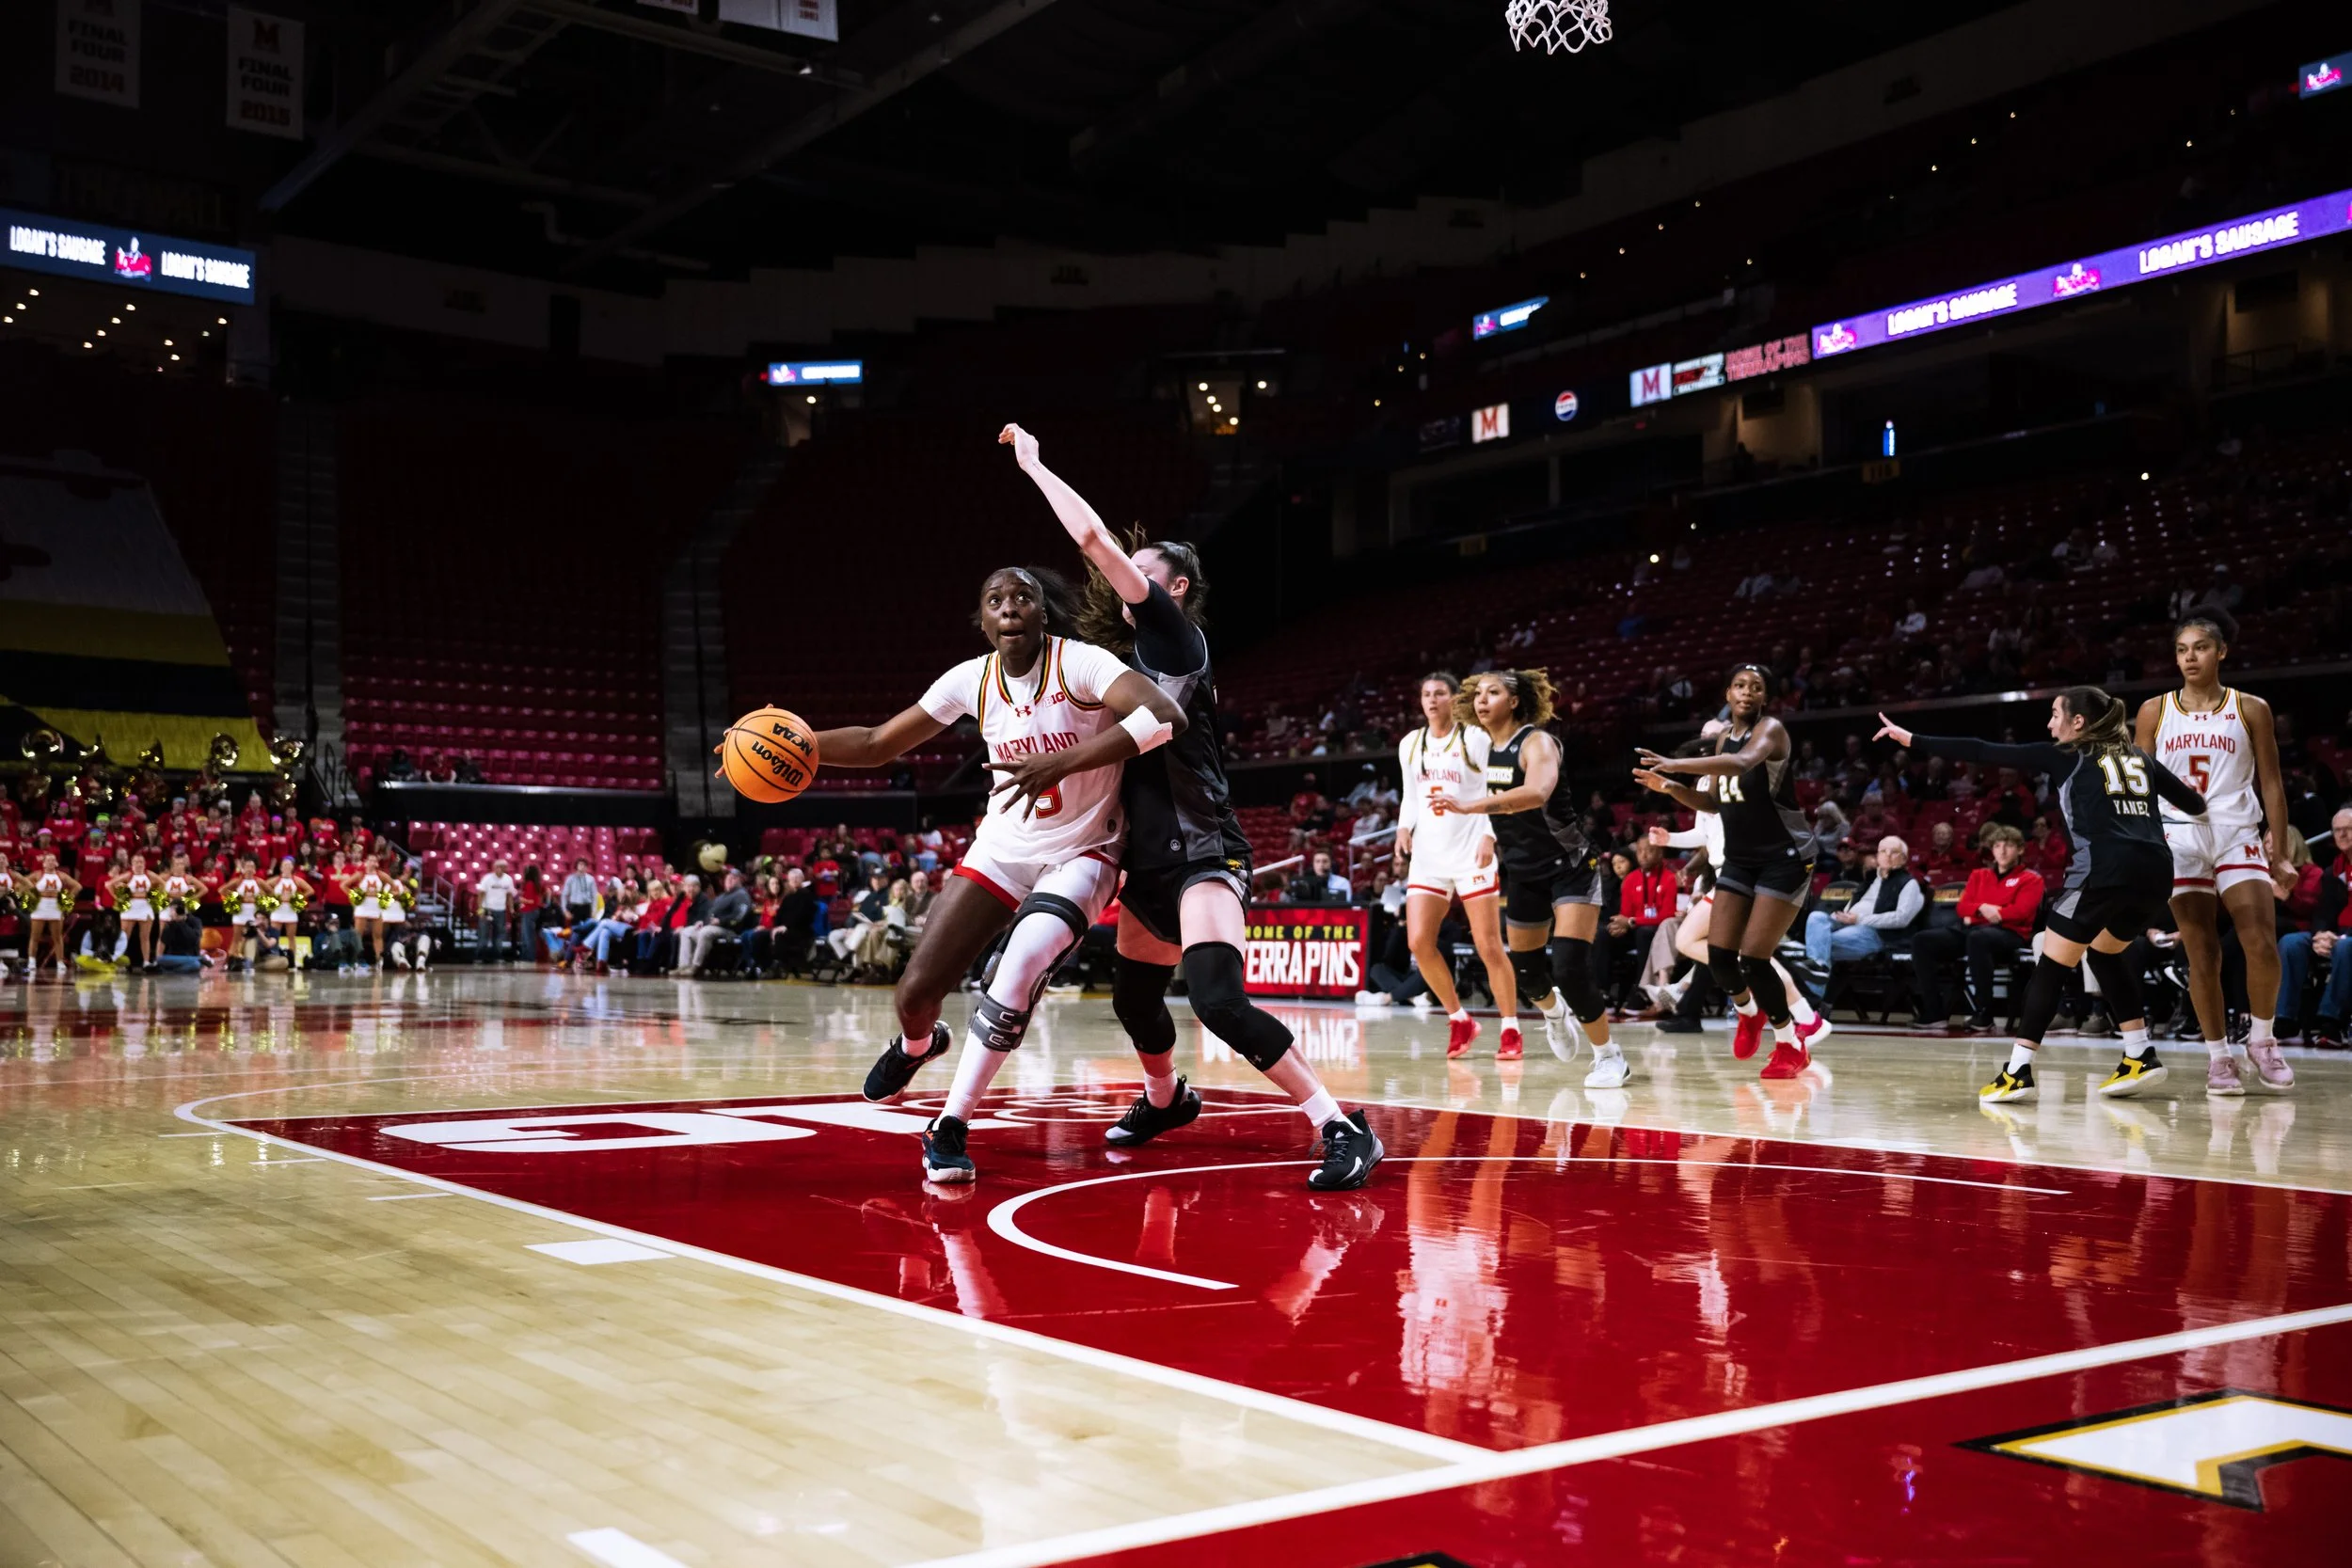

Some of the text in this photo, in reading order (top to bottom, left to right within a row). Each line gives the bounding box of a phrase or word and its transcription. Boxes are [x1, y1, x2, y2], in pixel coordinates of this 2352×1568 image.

[69, 20, 128, 47] FINAL
[72, 39, 125, 63] FOUR
[238, 56, 294, 82] FINAL
[241, 75, 291, 97] FOUR
[2139, 211, 2299, 275] LOGAN'S SAUSAGE
[1949, 282, 2018, 321] SAUSAGE
[1642, 368, 1661, 399] M
[1481, 406, 1498, 438] M
[772, 722, 813, 757] NCAA
[2166, 734, 2235, 754] MARYLAND
[752, 740, 803, 786] Wilson
[2098, 753, 2151, 798] 15
[2189, 754, 2210, 794] 5
[1718, 774, 1745, 803] 24
[2113, 800, 2151, 817] YANEZ
[2245, 844, 2261, 859] M
[1294, 925, 1313, 940] OF
[1323, 925, 1354, 940] THE
[1245, 941, 1361, 987] ERRAPINS
